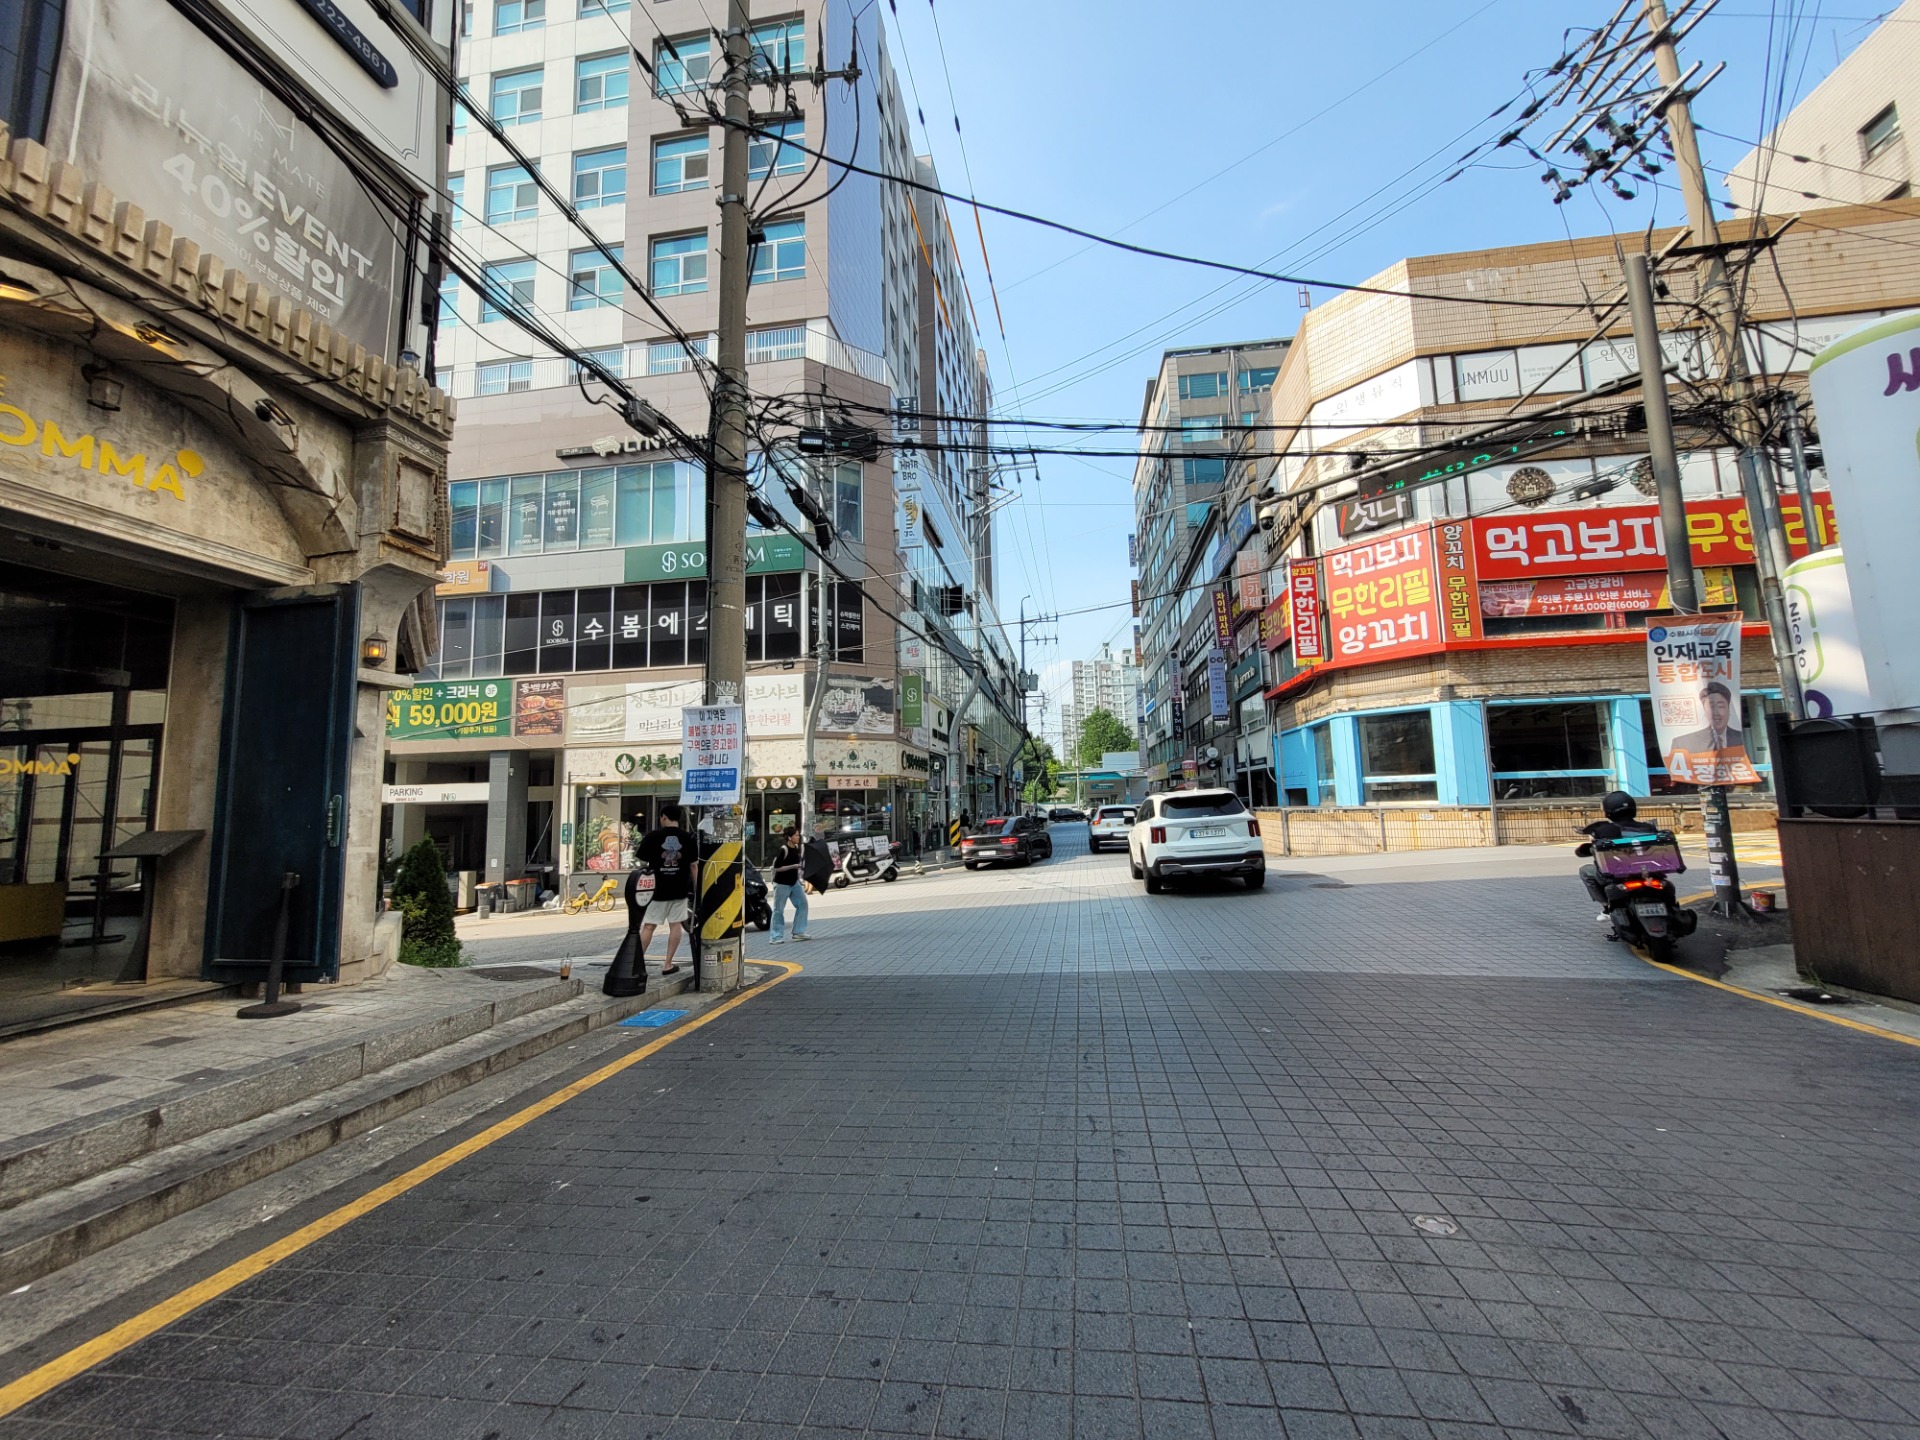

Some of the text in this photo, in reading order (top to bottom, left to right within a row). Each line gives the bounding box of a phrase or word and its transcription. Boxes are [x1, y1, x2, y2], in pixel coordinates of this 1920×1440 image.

[272, 148, 326, 201] MATE
[163, 153, 344, 306] 40%할인
[306, 297, 330, 318] 제외
[1600, 341, 1678, 362] 인생직
[1462, 368, 1509, 386] INMUU
[902, 471, 917, 480] BRO
[479, 562, 488, 570] 2F
[1332, 533, 1422, 578] 먹고보자
[437, 570, 470, 585] 학원
[1443, 525, 1472, 638] 양꼬치 무한리필
[1564, 577, 1624, 591] 고급양갈비
[1332, 568, 1431, 620] 무한리필
[1537, 589, 1652, 604] 2인분 주문시 1인분 서비스
[1216, 592, 1229, 636] 차이나 마사지
[1295, 577, 1318, 656] 무한리필
[1542, 605, 1548, 613] 2
[1339, 610, 1429, 654] 양꼬치
[1789, 602, 1807, 668] Nice to
[1654, 640, 1734, 664] 인재교육
[1656, 660, 1732, 685] 통합도시
[446, 685, 480, 699] 크리닉
[409, 701, 498, 728] 59,000원
[707, 708, 727, 721] 지역은
[726, 723, 737, 736] 금지
[687, 738, 738, 752] 구역으로 경고없이
[698, 753, 729, 766] 단속합니다
[829, 761, 844, 770] 청록
[863, 760, 878, 770] 식당
[1670, 752, 1694, 781] 4
[389, 788, 424, 797] PARKING
